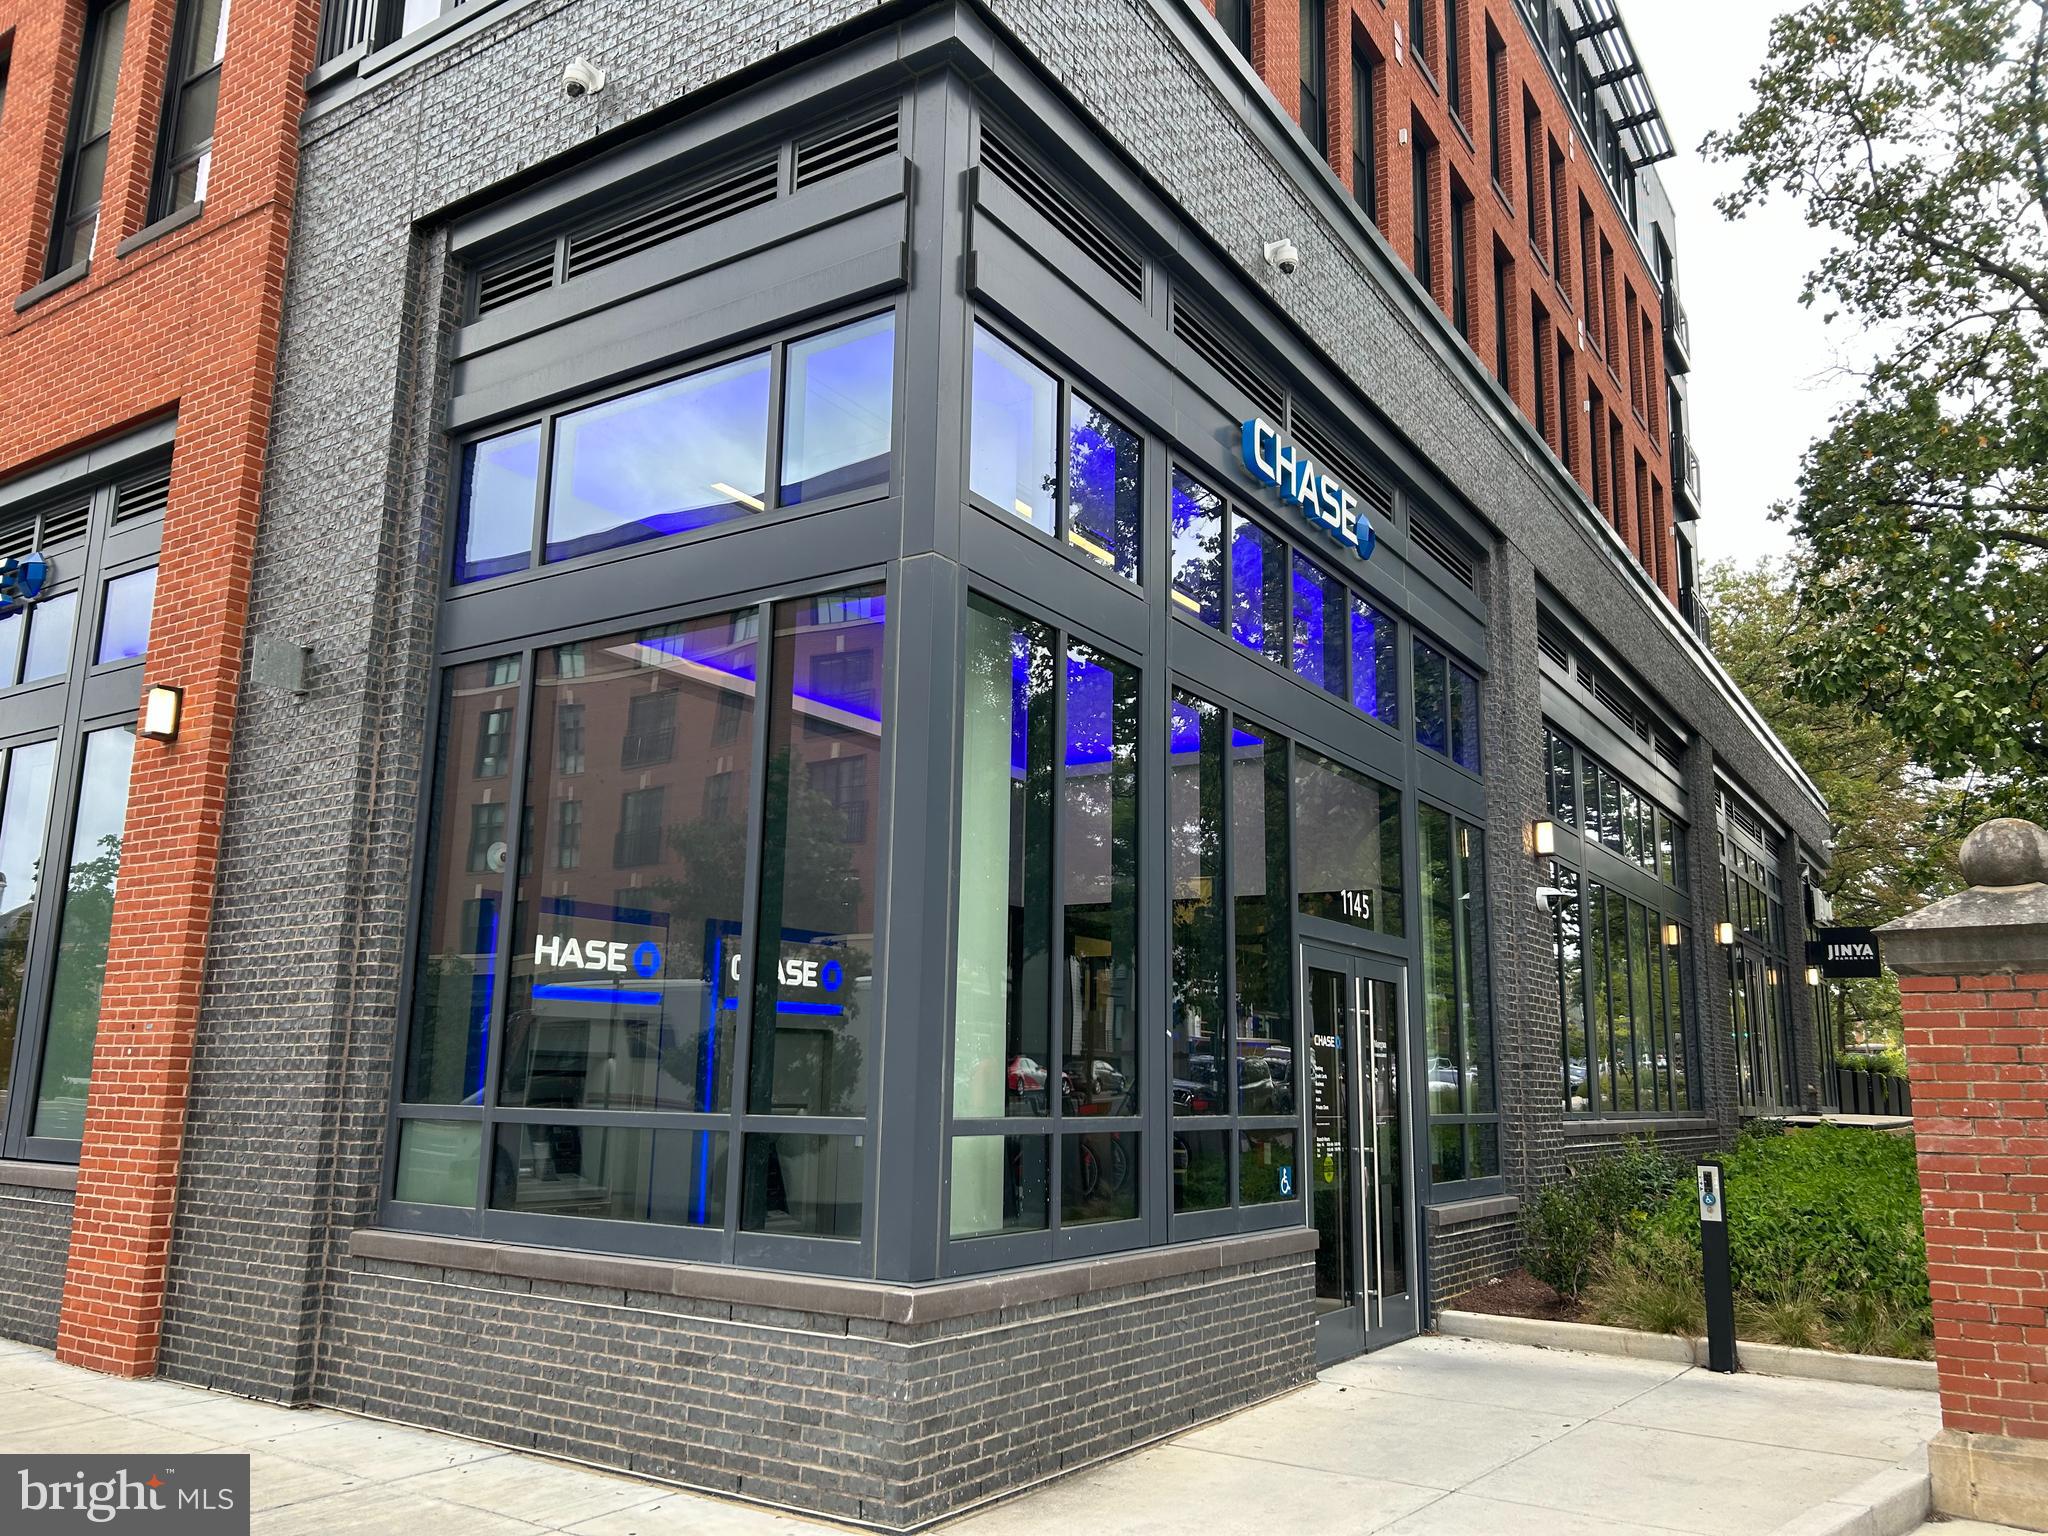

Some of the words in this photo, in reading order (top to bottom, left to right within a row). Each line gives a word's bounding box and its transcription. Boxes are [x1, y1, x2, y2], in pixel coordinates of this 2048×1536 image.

[1248, 417, 1359, 546] CHASE
[1340, 889, 1370, 920] 1145
[534, 934, 629, 972] HASE
[1827, 943, 1874, 961] JINYA
[1313, 1034, 1336, 1048] CHASE
